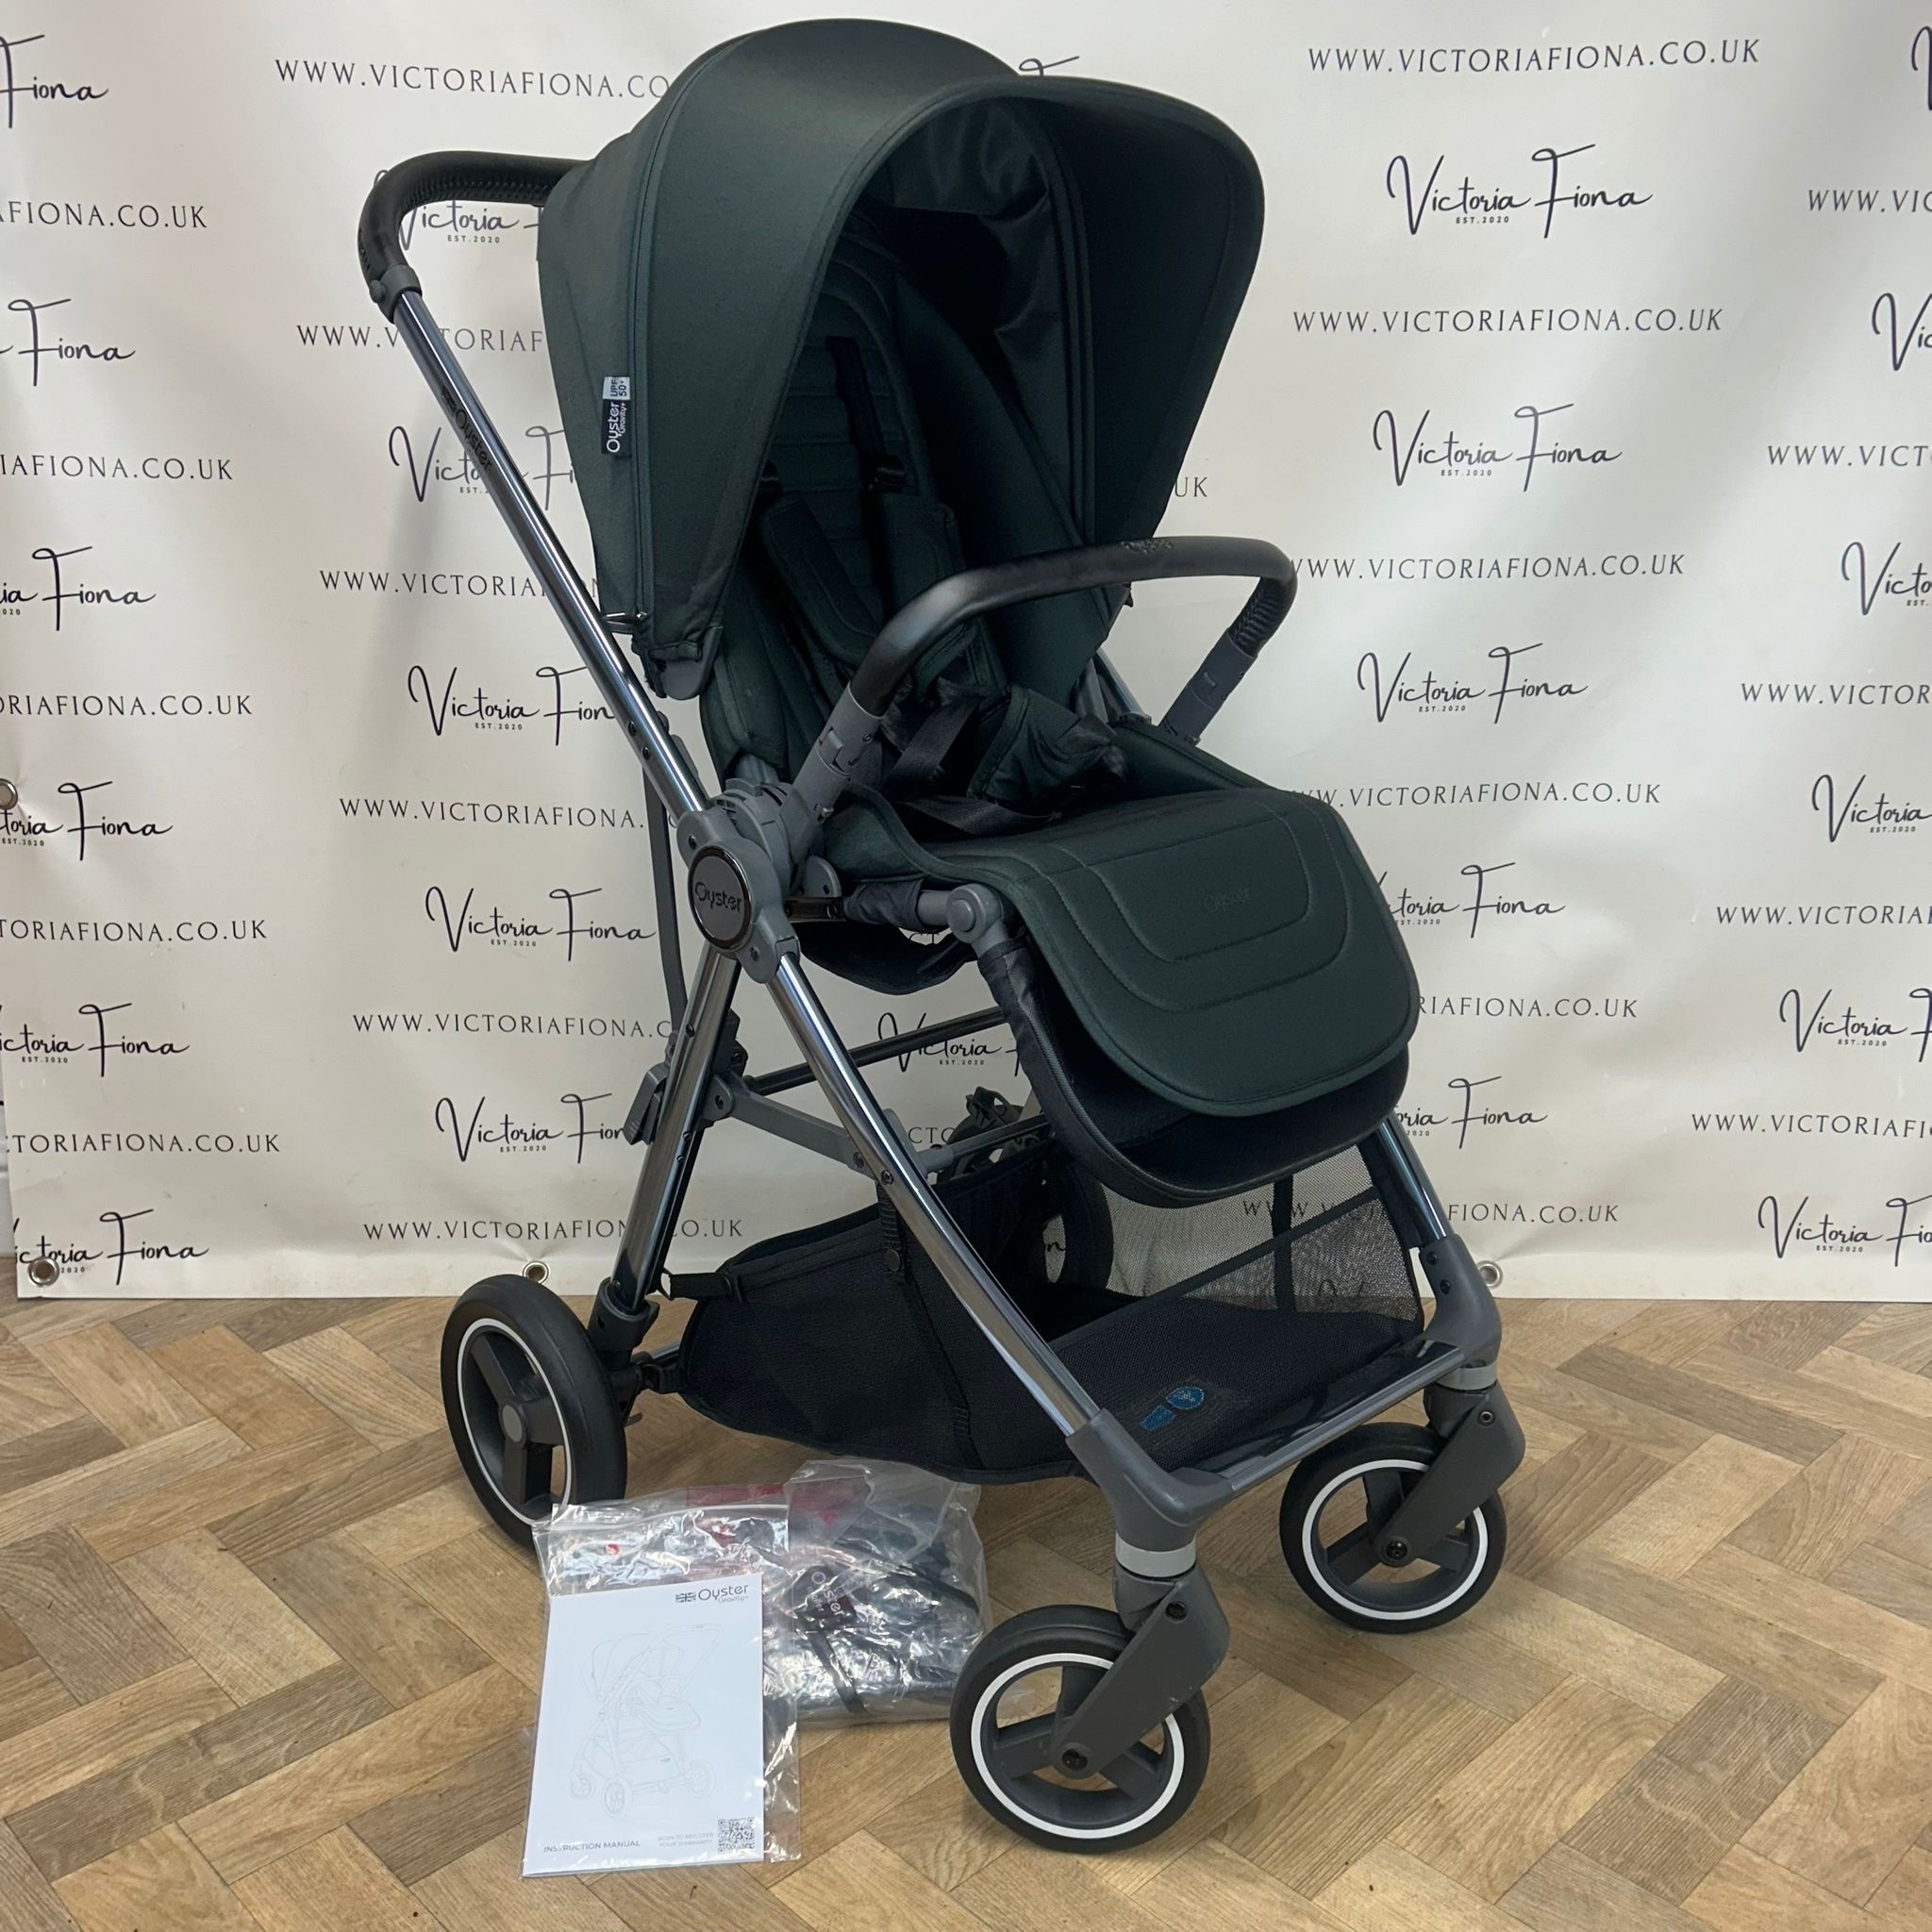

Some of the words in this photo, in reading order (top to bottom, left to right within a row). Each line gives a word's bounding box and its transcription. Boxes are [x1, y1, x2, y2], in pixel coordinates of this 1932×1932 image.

[1308, 39, 1760, 73] WWW.VICTORIAFIONA.CO.UK
[275, 59, 670, 98] WWW.VICTORIAFIONA.CO
[1387, 155, 1532, 235] Victoria
[1532, 143, 1654, 239] Fiona
[0, 200, 208, 228] FIONA.CO.UK
[1456, 216, 1509, 225] EST.2020
[447, 235, 501, 243] EST.2020
[1293, 308, 1724, 333] WWW.VICTORIAFIONA.CO.UK
[8, 298, 136, 387] Fiona
[456, 408, 493, 471] Oyster
[606, 401, 623, 453] Oyster
[1373, 409, 1513, 486] Victoria
[1514, 403, 1623, 492] Fiona
[1767, 444, 1932, 467] WWW.VICT
[32, 546, 157, 631] Fiona
[1357, 651, 1486, 723] Victoria
[1488, 642, 1589, 724] Fiona
[0, 695, 252, 716] RIAFIONA.CO.UK
[408, 665, 540, 736] Victoria
[536, 666, 615, 746] Fion
[475, 722, 523, 730] EST.2020
[58, 781, 173, 861] Fiona
[340, 798, 645, 828] WWW.VICTORIAFIONA.
[1812, 774, 1932, 842] Victoria
[2, 837, 44, 846] EST.2020
[1870, 825, 1916, 834] EST.2020
[694, 881, 741, 912] Oyster
[1460, 862, 1566, 939] Fiona
[425, 886, 553, 952] Victoria
[549, 888, 658, 962] Fiona
[78, 1003, 190, 1077] Fiona
[353, 1014, 671, 1039] WWW.VICTORIAFIONA.C
[1779, 989, 1907, 1052] Victoria
[435, 1097, 563, 1161] Victoria
[1448, 1075, 1548, 1149] Fiona
[1691, 1113, 1932, 1139] WWW.VICTORIAFI
[8, 1134, 280, 1153] TORIAFIONA.CO.UK
[1757, 1195, 1883, 1258] Victoria
[99, 1208, 209, 1286] Fiona
[1816, 1244, 1863, 1253] EST.2020
[698, 1585, 749, 1601] Oyster
[543, 1842, 601, 1853] INSTRUCTION
[604, 1840, 641, 1849] MANUAL
